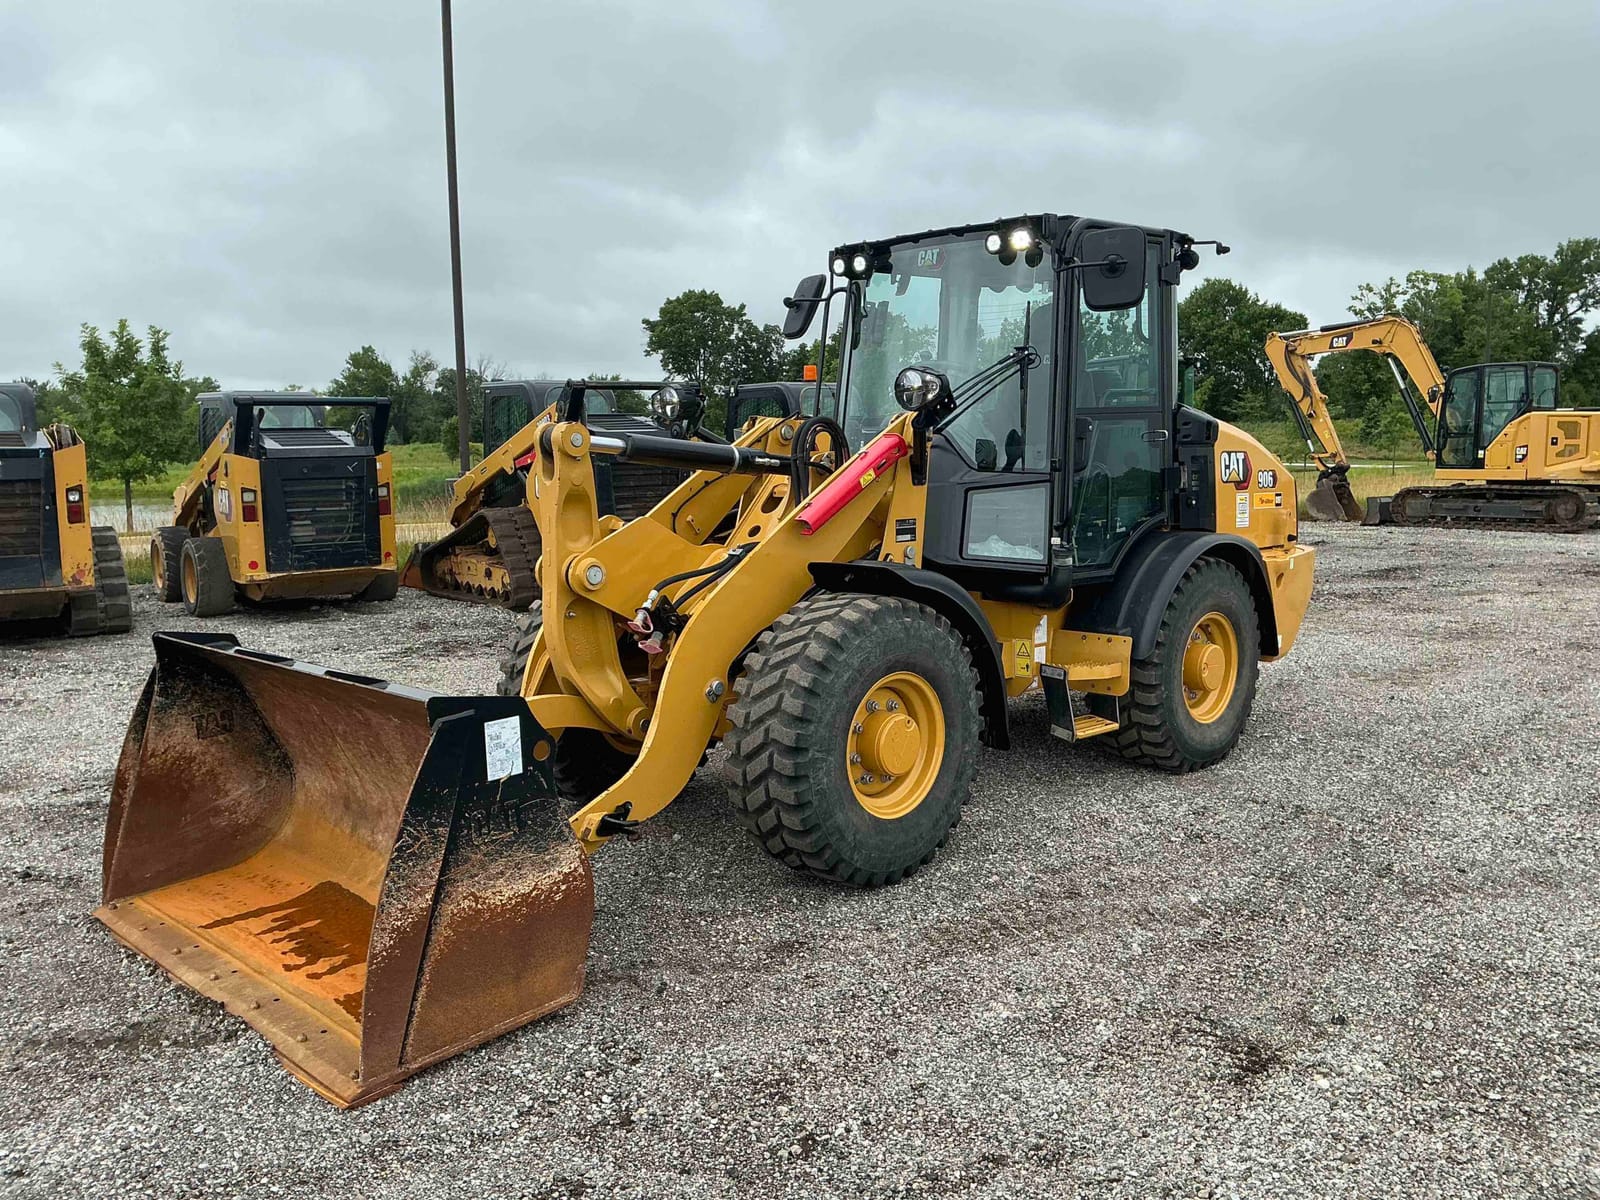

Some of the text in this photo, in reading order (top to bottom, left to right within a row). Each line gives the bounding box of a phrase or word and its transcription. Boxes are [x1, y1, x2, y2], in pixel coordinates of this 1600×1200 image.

[918, 247, 940, 267] CAT
[1333, 336, 1347, 348] CAT
[1221, 452, 1245, 482] CAT
[1258, 471, 1273, 488] 906
